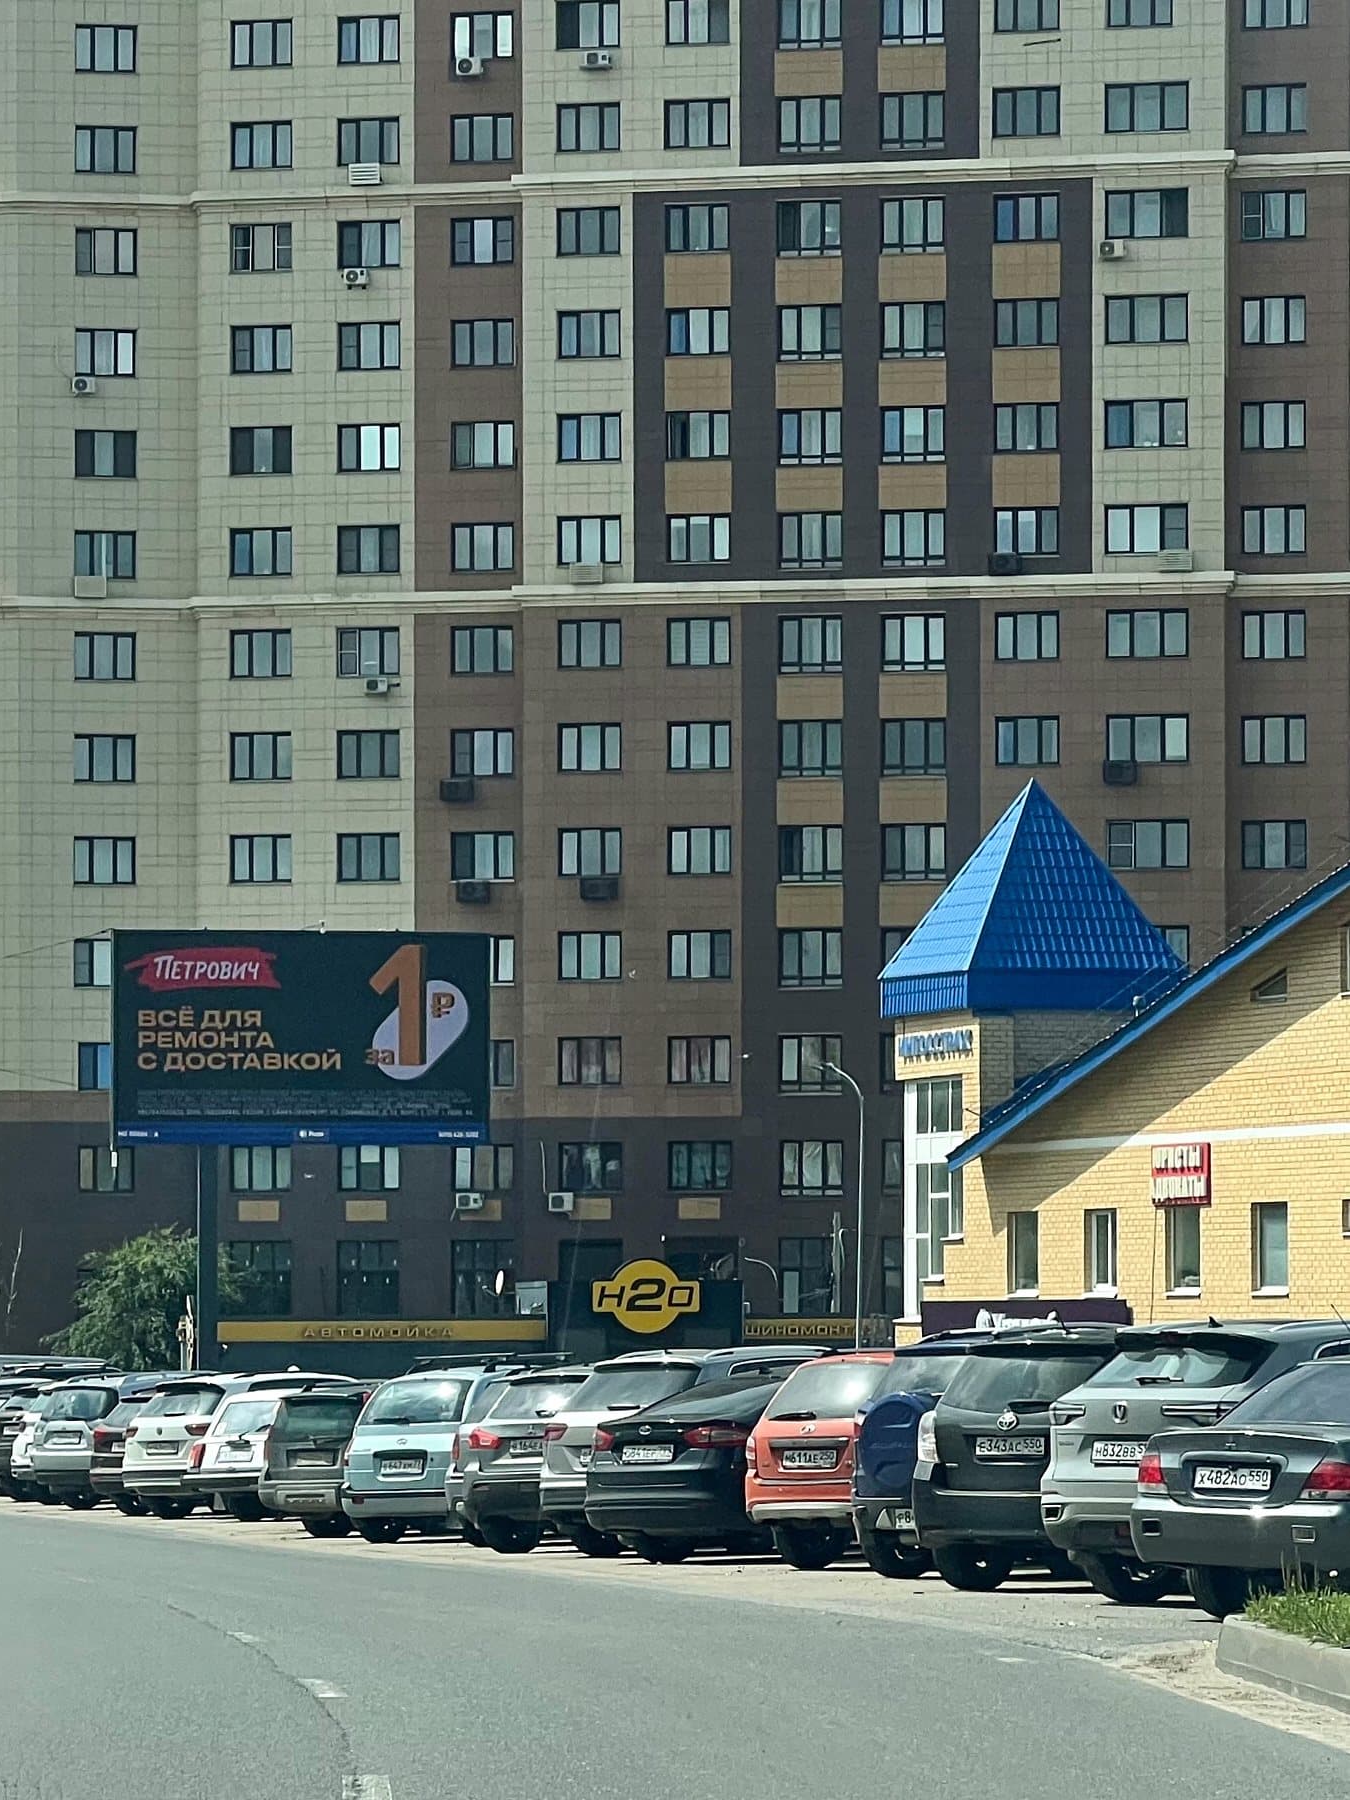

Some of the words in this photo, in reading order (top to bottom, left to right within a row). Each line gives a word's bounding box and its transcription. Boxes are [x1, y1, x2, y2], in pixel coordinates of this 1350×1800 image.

[369, 943, 427, 1066] 1
[137, 1005, 195, 1028] ВСЁ
[201, 1009, 263, 1030] ДЛЯ
[137, 1031, 275, 1049] РЕМОНТА
[136, 1051, 158, 1070] С
[163, 1048, 342, 1072] ДОСТАВКОЙ
[304, 1325, 453, 1338] АВТОМОЙКА
